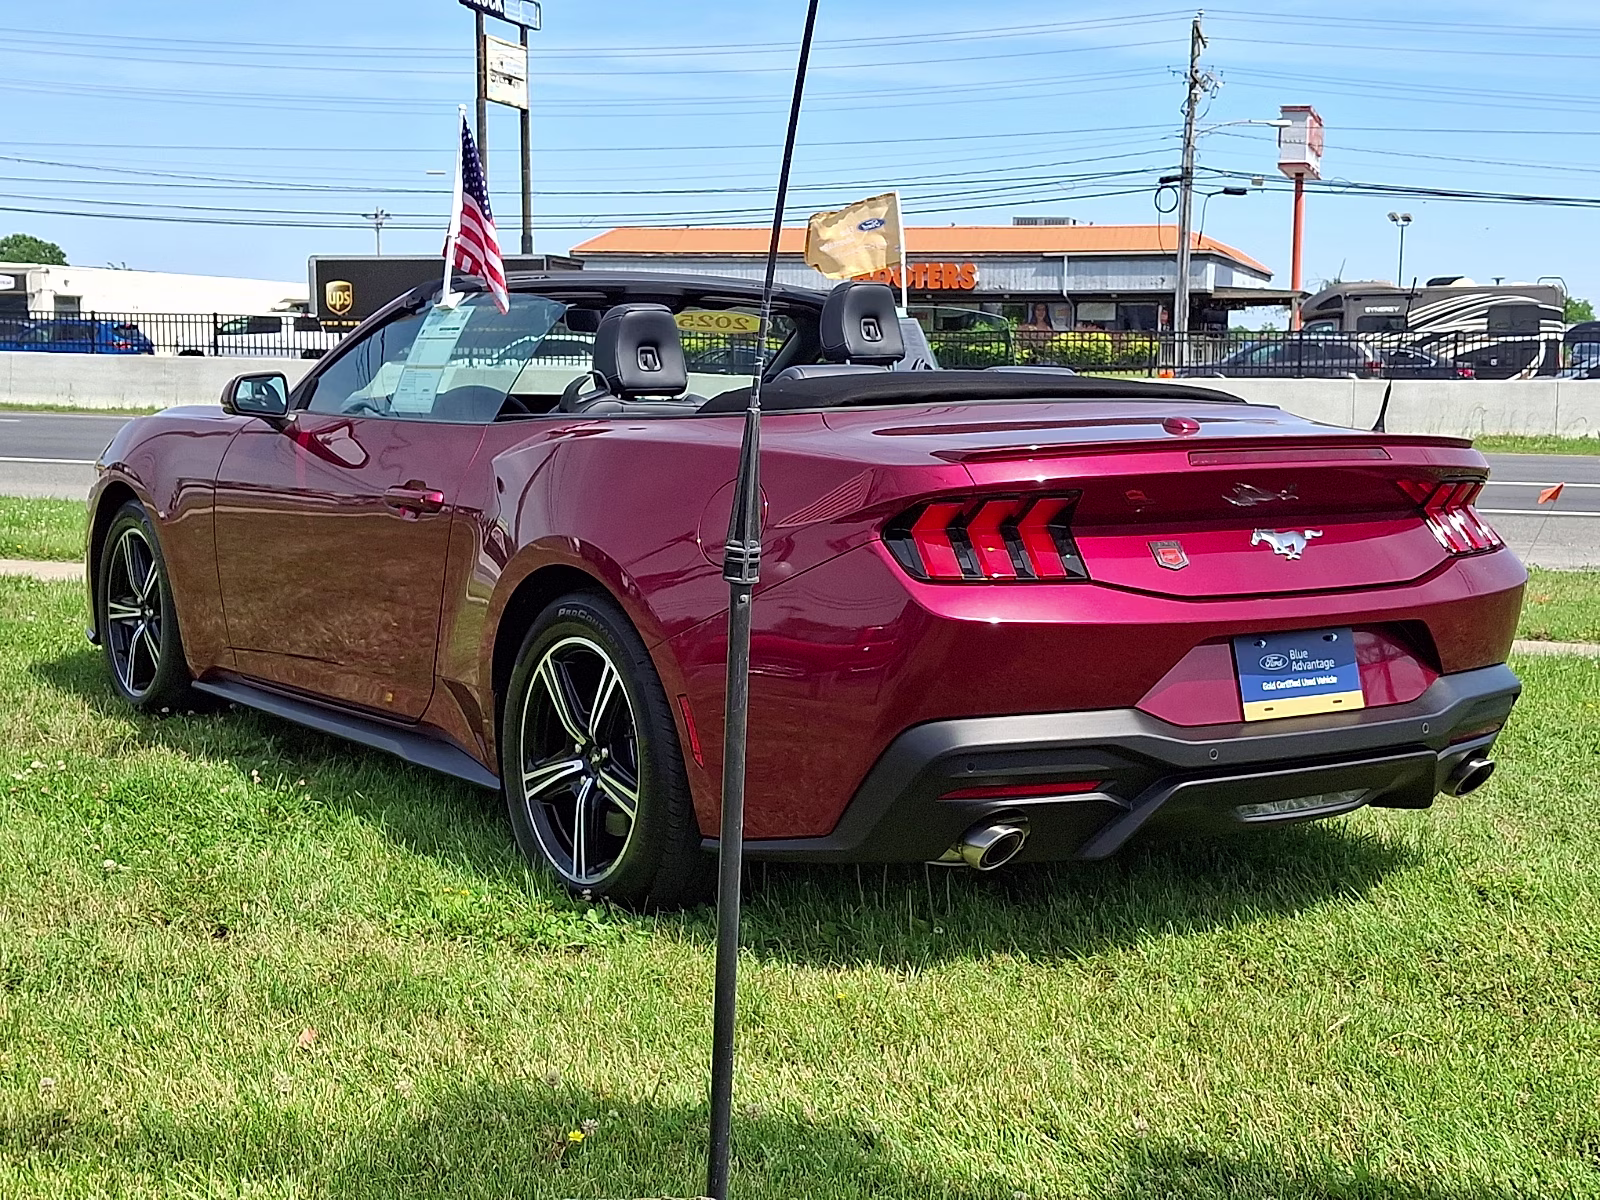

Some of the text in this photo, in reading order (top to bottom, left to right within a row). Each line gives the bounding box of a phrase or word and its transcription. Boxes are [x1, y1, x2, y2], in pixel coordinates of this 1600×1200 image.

[328, 291, 351, 310] ups
[1289, 649, 1309, 660] Blue
[1291, 659, 1335, 672] Advantage
[1262, 675, 1338, 691] Gold Certified Used Vehicle
